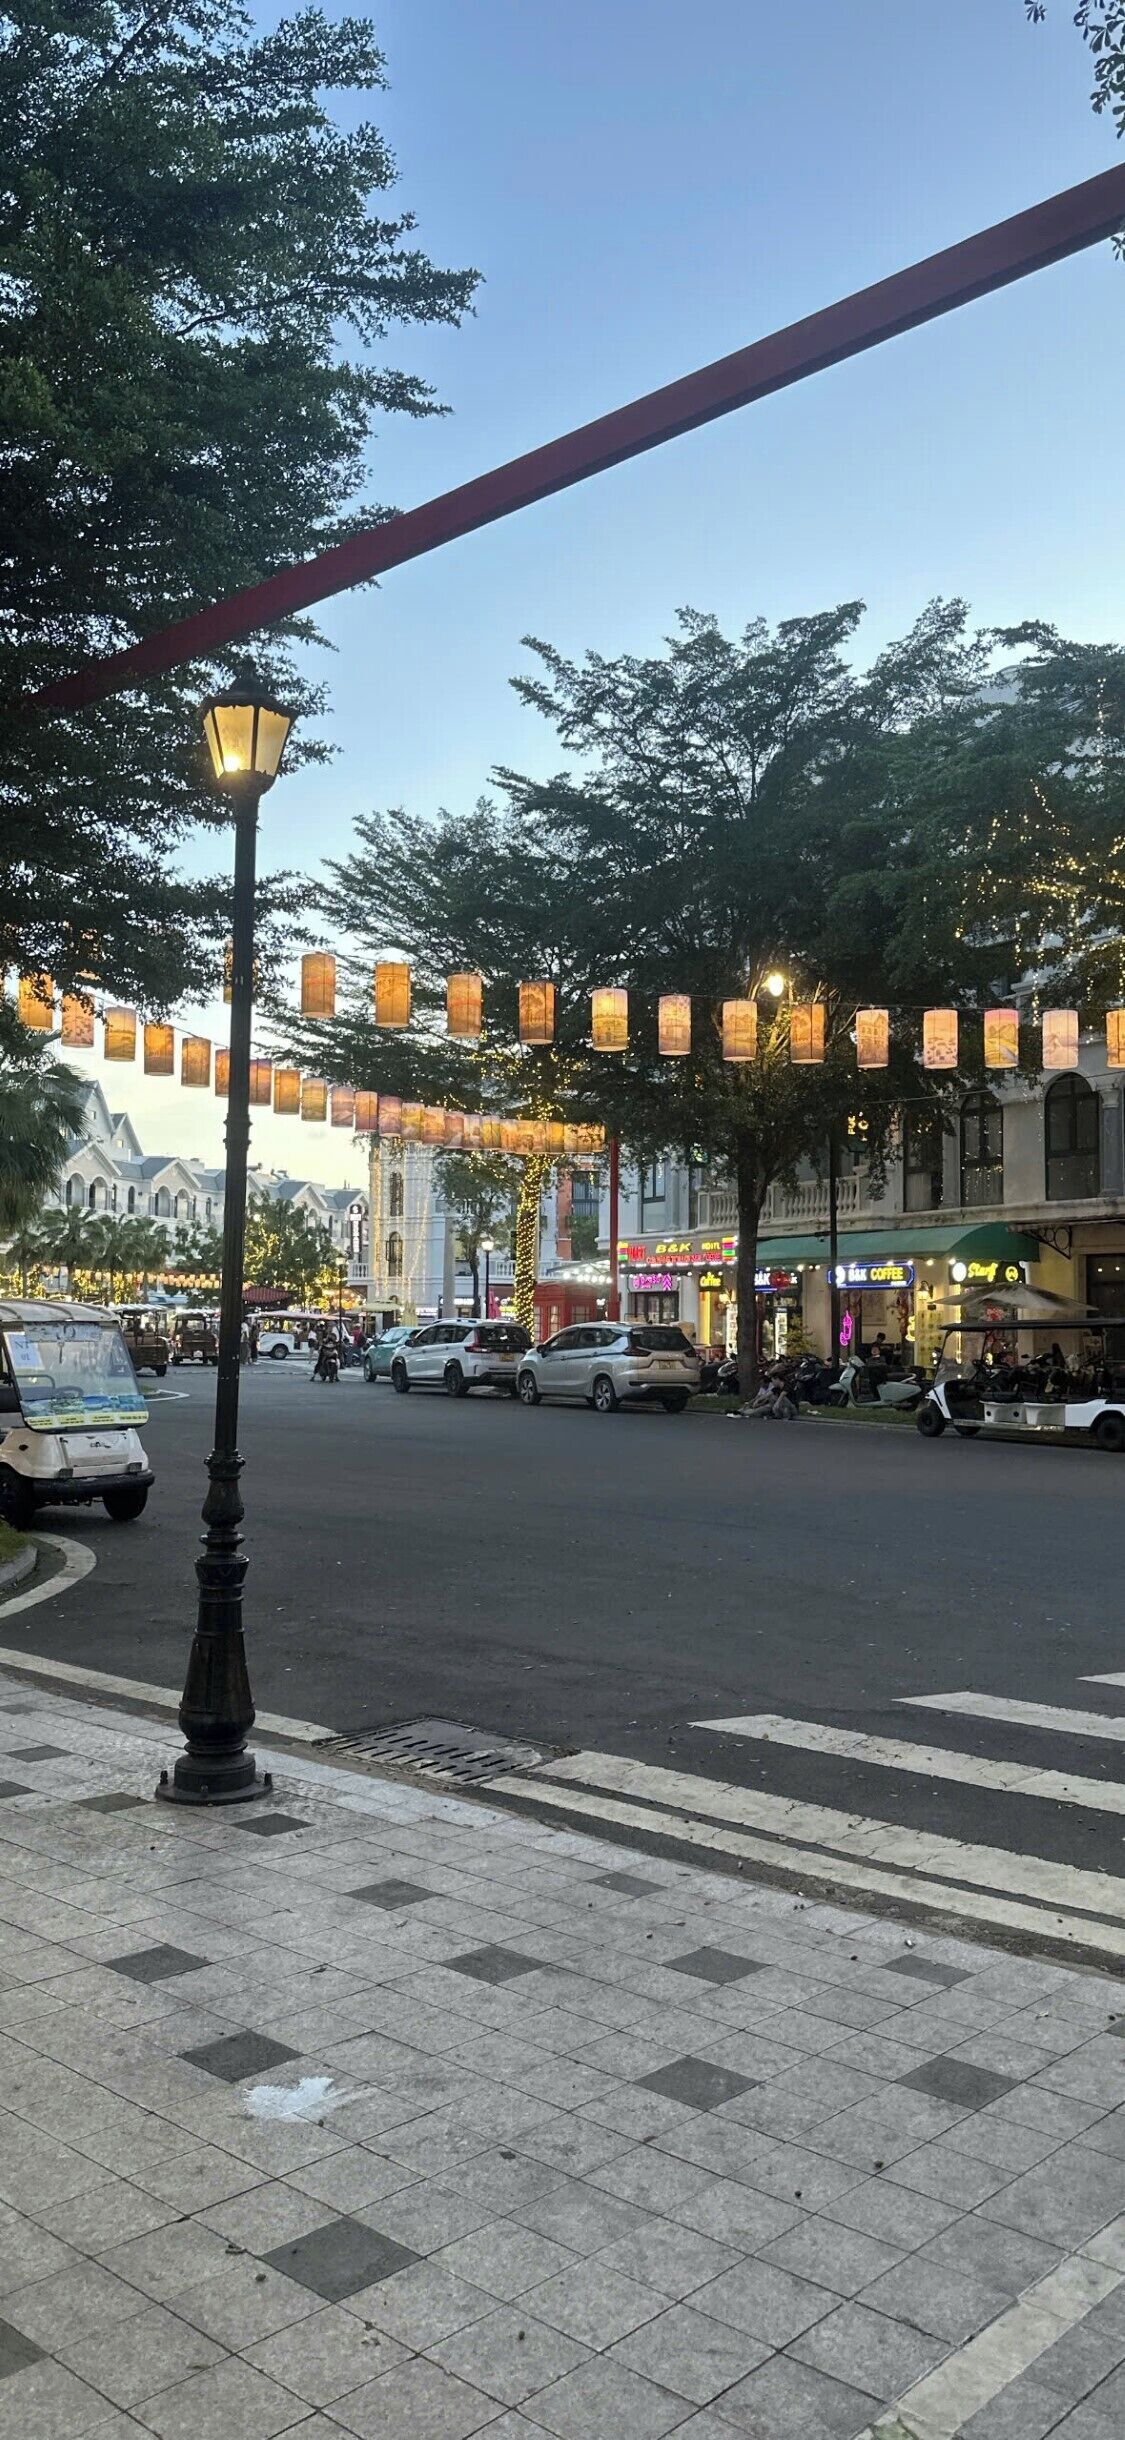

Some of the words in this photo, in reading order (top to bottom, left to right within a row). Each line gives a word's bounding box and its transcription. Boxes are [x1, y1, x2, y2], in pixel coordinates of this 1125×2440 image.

[655, 1242, 691, 1254] B&K
[847, 1268, 867, 1282] B&K
[870, 1267, 904, 1281] COFFEE
